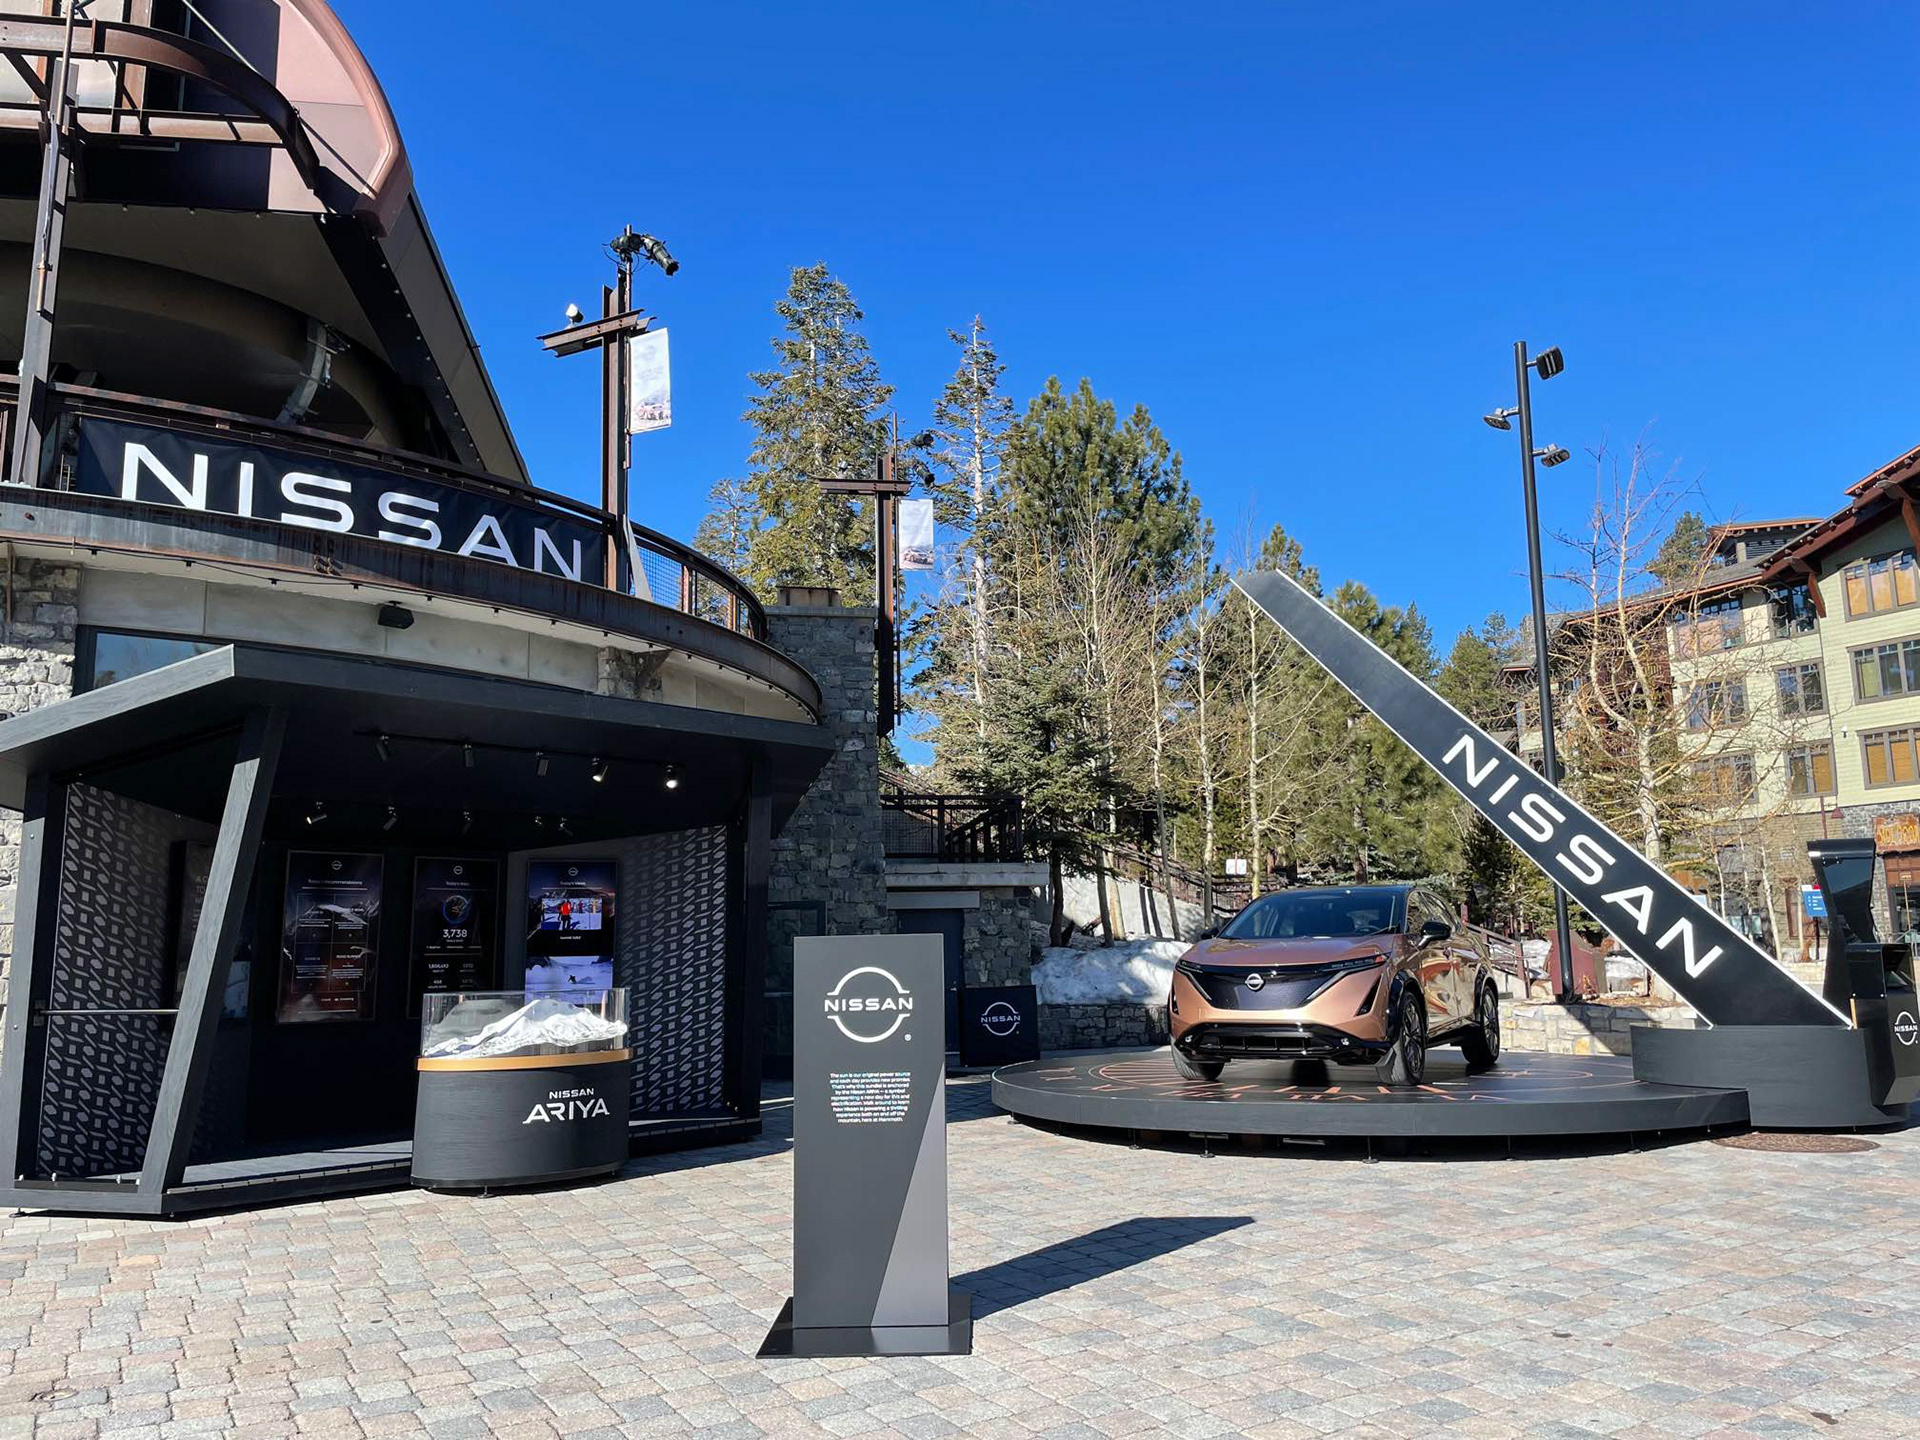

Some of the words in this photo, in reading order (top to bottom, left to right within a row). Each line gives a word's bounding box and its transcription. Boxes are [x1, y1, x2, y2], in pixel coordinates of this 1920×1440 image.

[122, 442, 582, 581] NISSAN
[1441, 734, 1723, 979] NISSAN
[442, 928, 468, 938] 3,738
[824, 997, 913, 1012] NISSAN
[980, 1014, 1020, 1023] NISSAN
[1894, 1024, 1918, 1032] NISSAN
[549, 1087, 595, 1100] NISSAN
[522, 1100, 610, 1124] ARIYA
